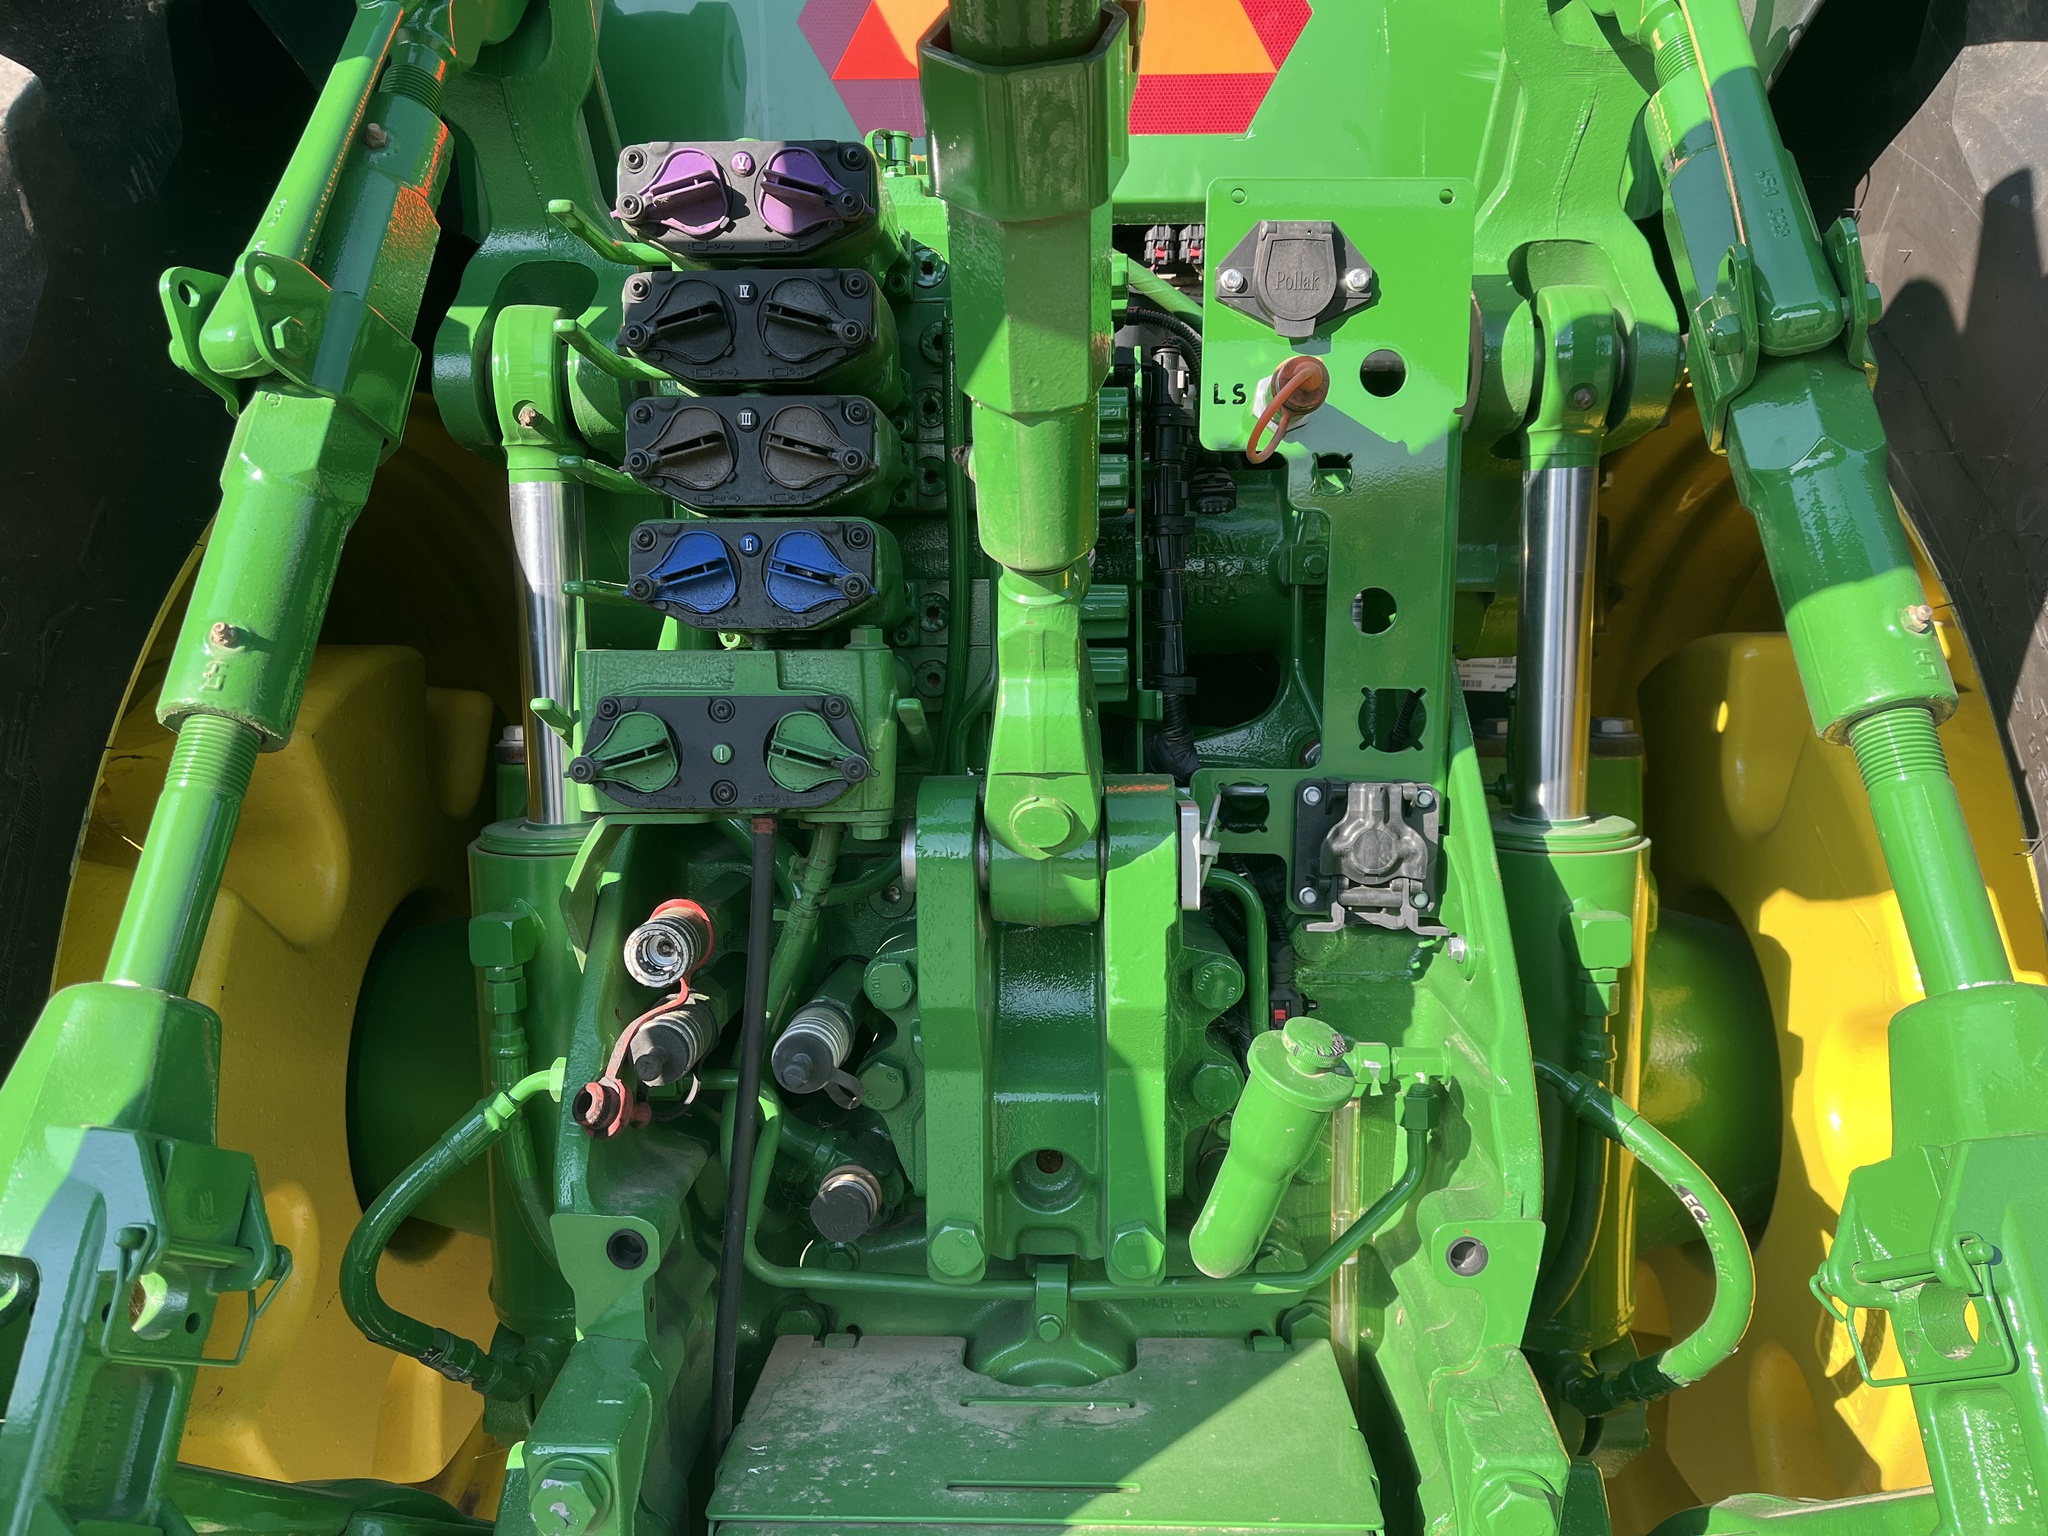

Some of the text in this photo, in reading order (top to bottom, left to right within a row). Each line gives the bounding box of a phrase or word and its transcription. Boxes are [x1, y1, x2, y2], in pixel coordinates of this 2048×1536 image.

[734, 155, 747, 170] V
[1274, 271, 1320, 291] Pollak
[739, 285, 750, 298] IV
[1213, 382, 1247, 405] LS
[740, 412, 752, 426] III
[1195, 583, 1239, 605] USA
